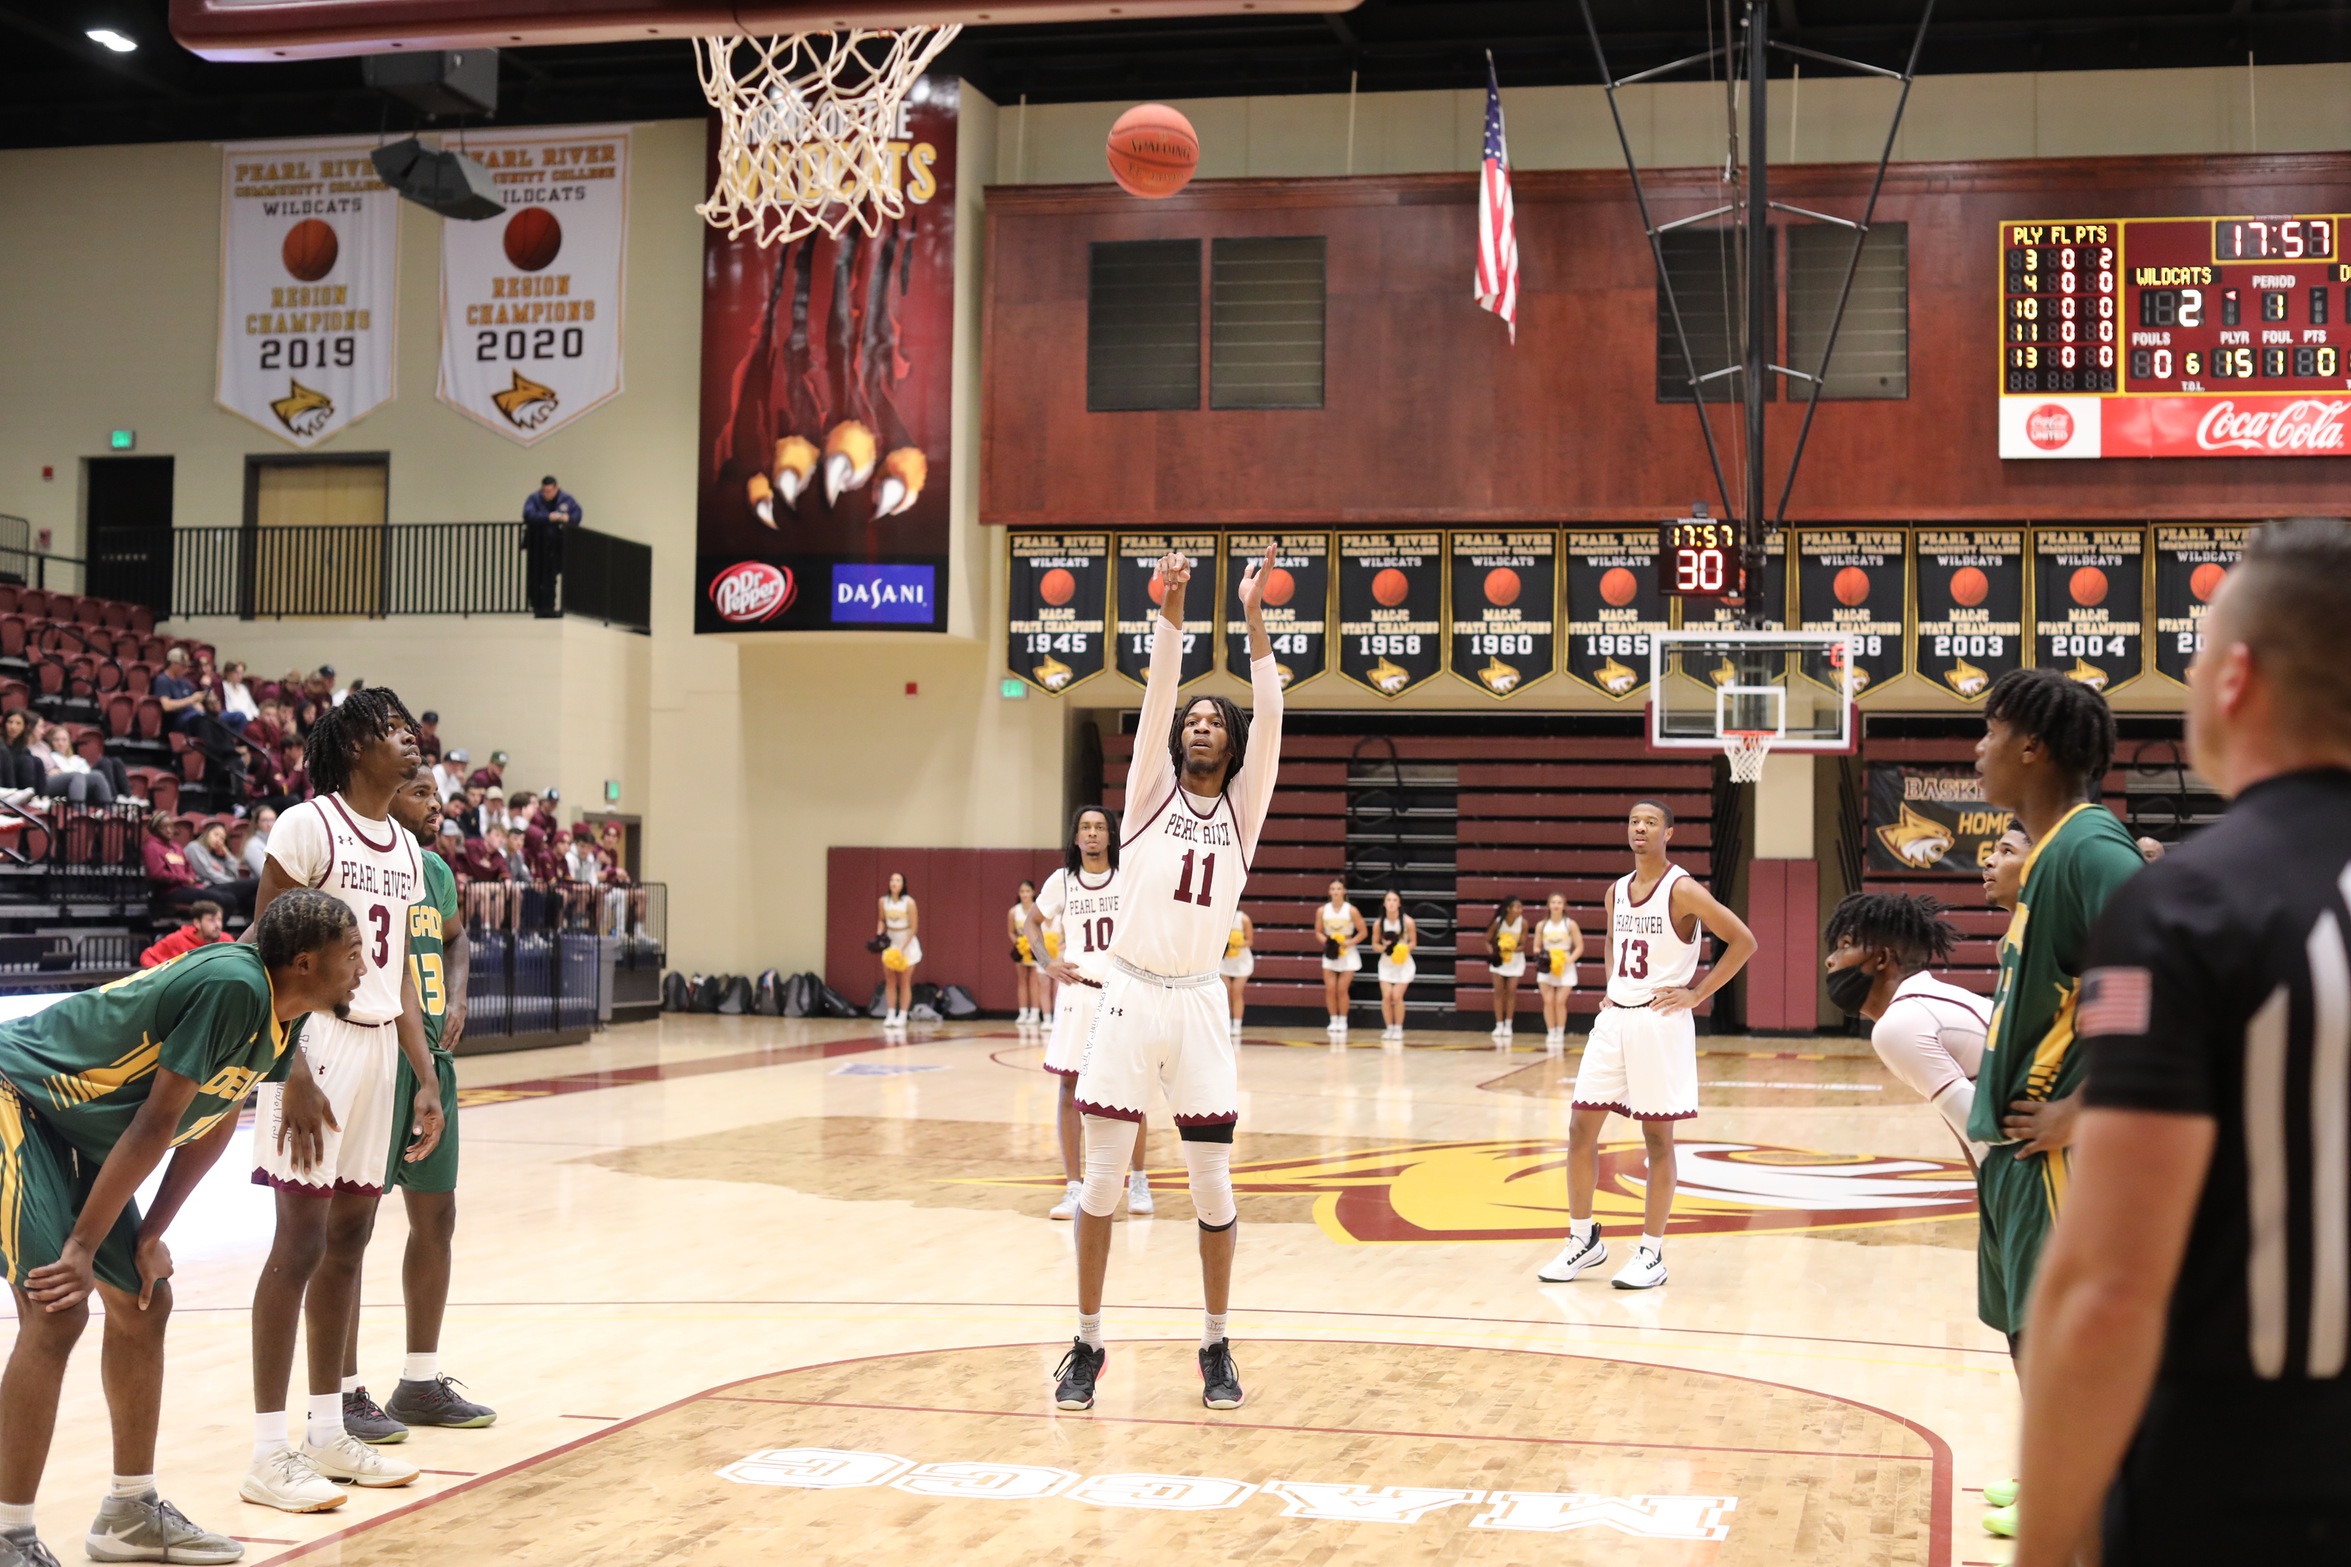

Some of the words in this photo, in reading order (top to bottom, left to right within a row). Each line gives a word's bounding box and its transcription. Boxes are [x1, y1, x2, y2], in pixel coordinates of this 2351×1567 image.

[468, 149, 532, 169] EARL
[542, 144, 615, 166] RIVER
[235, 161, 311, 182] PEARL
[320, 158, 375, 178] RIVE
[502, 186, 586, 204] ILDCATS
[263, 198, 362, 216] WILDCATS
[2014, 226, 2043, 245] PLY
[2051, 226, 2071, 244] FL
[2075, 225, 2108, 244] PTS
[2235, 221, 2330, 258] 17:57
[2025, 249, 2038, 271] 3
[2061, 248, 2075, 270] 0
[2099, 248, 2113, 270] 2
[2023, 273, 2038, 293] 4
[2061, 271, 2075, 293] 0
[2099, 271, 2113, 293] 0
[2135, 267, 2212, 286] WILDCATS
[2252, 275, 2296, 289] PERIOD
[2340, 264, 2351, 283] D
[271, 286, 347, 308] REGION
[492, 275, 571, 299] REGION
[467, 300, 595, 326] CHAMPIONS
[2016, 297, 2038, 320] 10
[2061, 297, 2075, 319] 0
[2099, 297, 2113, 319] 0
[2178, 289, 2202, 328] 2
[2276, 294, 2284, 319] 1
[245, 310, 371, 336] CHAMPIONS
[2016, 323, 2038, 343] 11
[2061, 320, 2075, 342] 0
[2099, 320, 2113, 342] 0
[477, 327, 584, 361] 2020
[2132, 331, 2171, 346] FOULS
[2220, 331, 2250, 345] PLYR
[2262, 330, 2293, 344] FOUL
[2303, 329, 2327, 343] PTS
[260, 337, 355, 370] 2019
[2016, 346, 2038, 369] 13
[2061, 346, 2075, 368] 0
[2099, 346, 2113, 368] 0
[2185, 352, 2200, 375] 6
[2225, 348, 2253, 378] 15
[2277, 350, 2284, 375] 1
[2317, 347, 2336, 377] 0
[2153, 349, 2172, 379] 0
[2196, 400, 2351, 450] Coca-Cola
[1013, 536, 1059, 547] PEARL
[1063, 536, 1106, 547] RIVER
[1120, 536, 1168, 548] PEARL
[1171, 536, 1215, 548] RIVER
[1230, 535, 1275, 547] PEARL
[1281, 535, 1326, 547] RIVER
[1342, 535, 1390, 547] PEARL
[1394, 534, 1439, 546] RIVER
[1454, 534, 1503, 545] PEARL
[1507, 534, 1552, 546] RIVER
[1569, 534, 1618, 546] PEARL
[1622, 533, 1659, 546] RIVE
[1674, 525, 1733, 549] 17:57
[1801, 532, 1851, 545] PEARL
[1855, 532, 1902, 545] RIVER
[1919, 532, 1969, 545] PEARL
[1974, 532, 2020, 545] RIVER
[2038, 532, 2088, 545] PEARL
[2093, 531, 2141, 545] RIVER
[2158, 528, 2209, 540] PEARL
[2214, 528, 2250, 541] RIVE
[1029, 557, 1090, 568] WILDCATS
[1359, 556, 1422, 567] WILDCATS
[1472, 556, 1535, 566] WILDCATS
[1587, 556, 1651, 567] WILDCATS
[1820, 555, 1884, 566] WILDCATS
[1937, 555, 2003, 566] WILDCATS
[2056, 554, 2122, 566] WILDCATS
[2176, 551, 2242, 562] WILDCATS
[1678, 550, 1723, 590] 30
[739, 570, 764, 594] Dr
[722, 576, 780, 615] Pepper
[838, 578, 924, 609] DASANI
[1453, 622, 1487, 634] STATE
[1569, 622, 1601, 634] STATE
[1918, 621, 1953, 635] STATE
[1955, 621, 2021, 635] CHAMPIONS
[2037, 621, 2072, 635] STATE
[2075, 621, 2140, 635] CHAMPIONS
[2158, 618, 2193, 632] STATE
[1026, 633, 1087, 653] 1945
[1132, 634, 1196, 654] 197
[1243, 634, 1308, 654] 148
[1360, 635, 1421, 655] 1958
[1471, 634, 1533, 655] 1960
[1586, 634, 1650, 656] 1965
[1934, 635, 2004, 657] 2003
[2052, 635, 2126, 657] 2004
[341, 861, 379, 894] PEARL
[1173, 848, 1215, 907] 11
[1070, 897, 1097, 915] PEARL
[1099, 895, 1120, 912] RIVE
[1083, 916, 1114, 953] 10
[1635, 916, 1663, 934] RIVER
[368, 903, 391, 969] 3
[1618, 938, 1649, 980] 13
[715, 1447, 1738, 1541] MACCC
